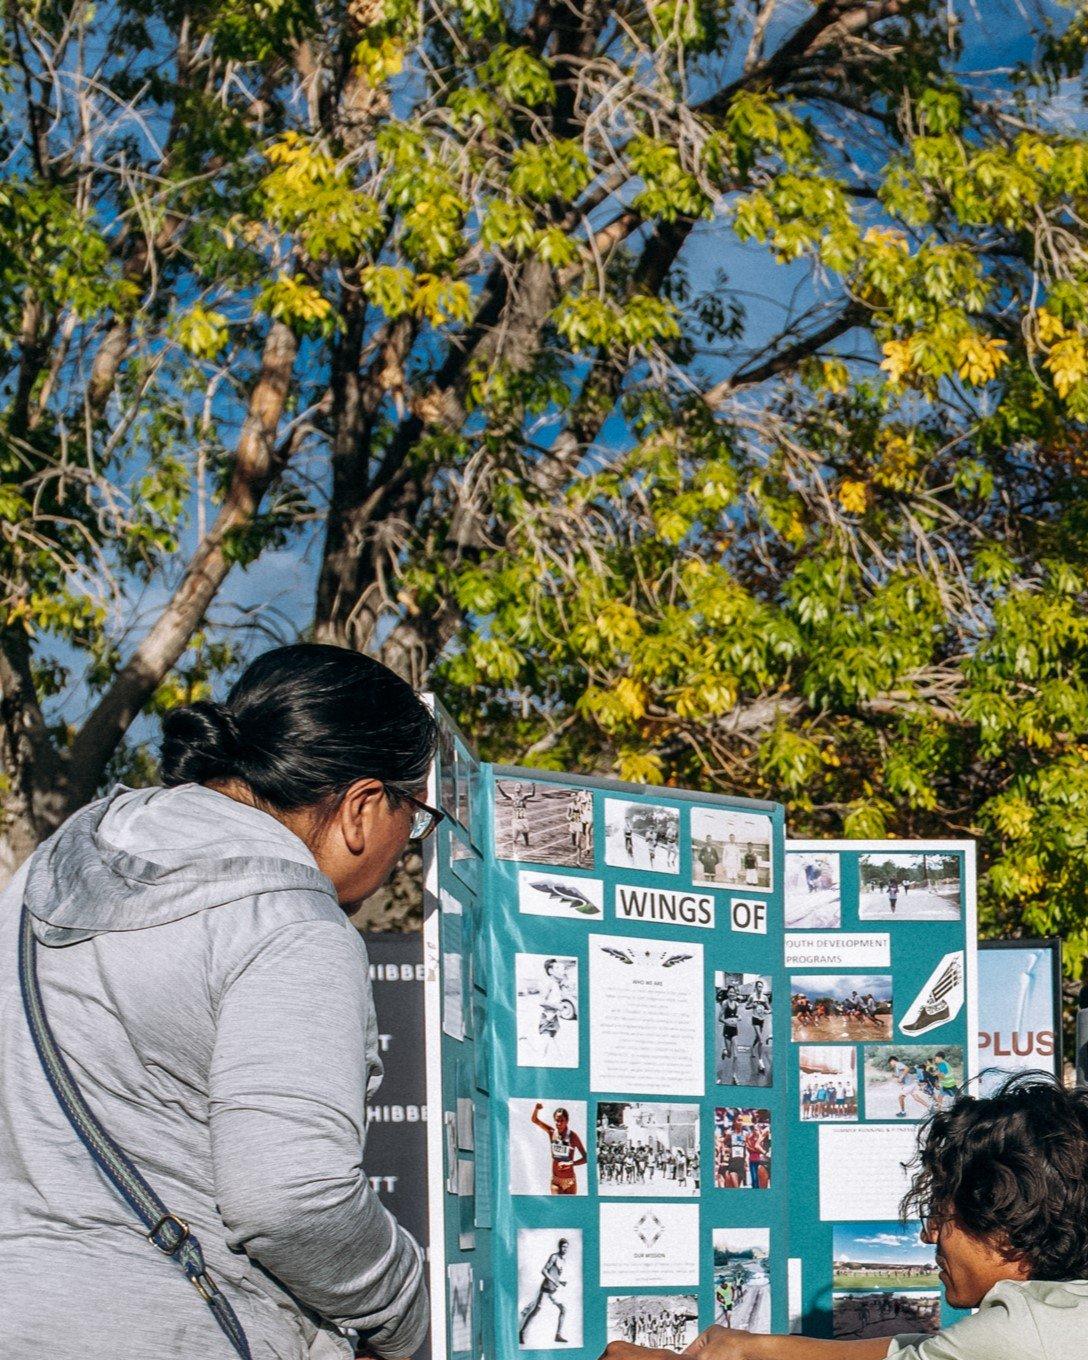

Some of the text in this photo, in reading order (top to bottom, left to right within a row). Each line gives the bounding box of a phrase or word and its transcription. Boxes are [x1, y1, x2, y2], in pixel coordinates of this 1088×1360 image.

[620, 889, 765, 929] WINGS OF
[785, 939, 887, 948] OUTH DEVELOPMENT
[786, 955, 842, 963] PROGRAMS
[978, 1030, 1056, 1057] PLUS
